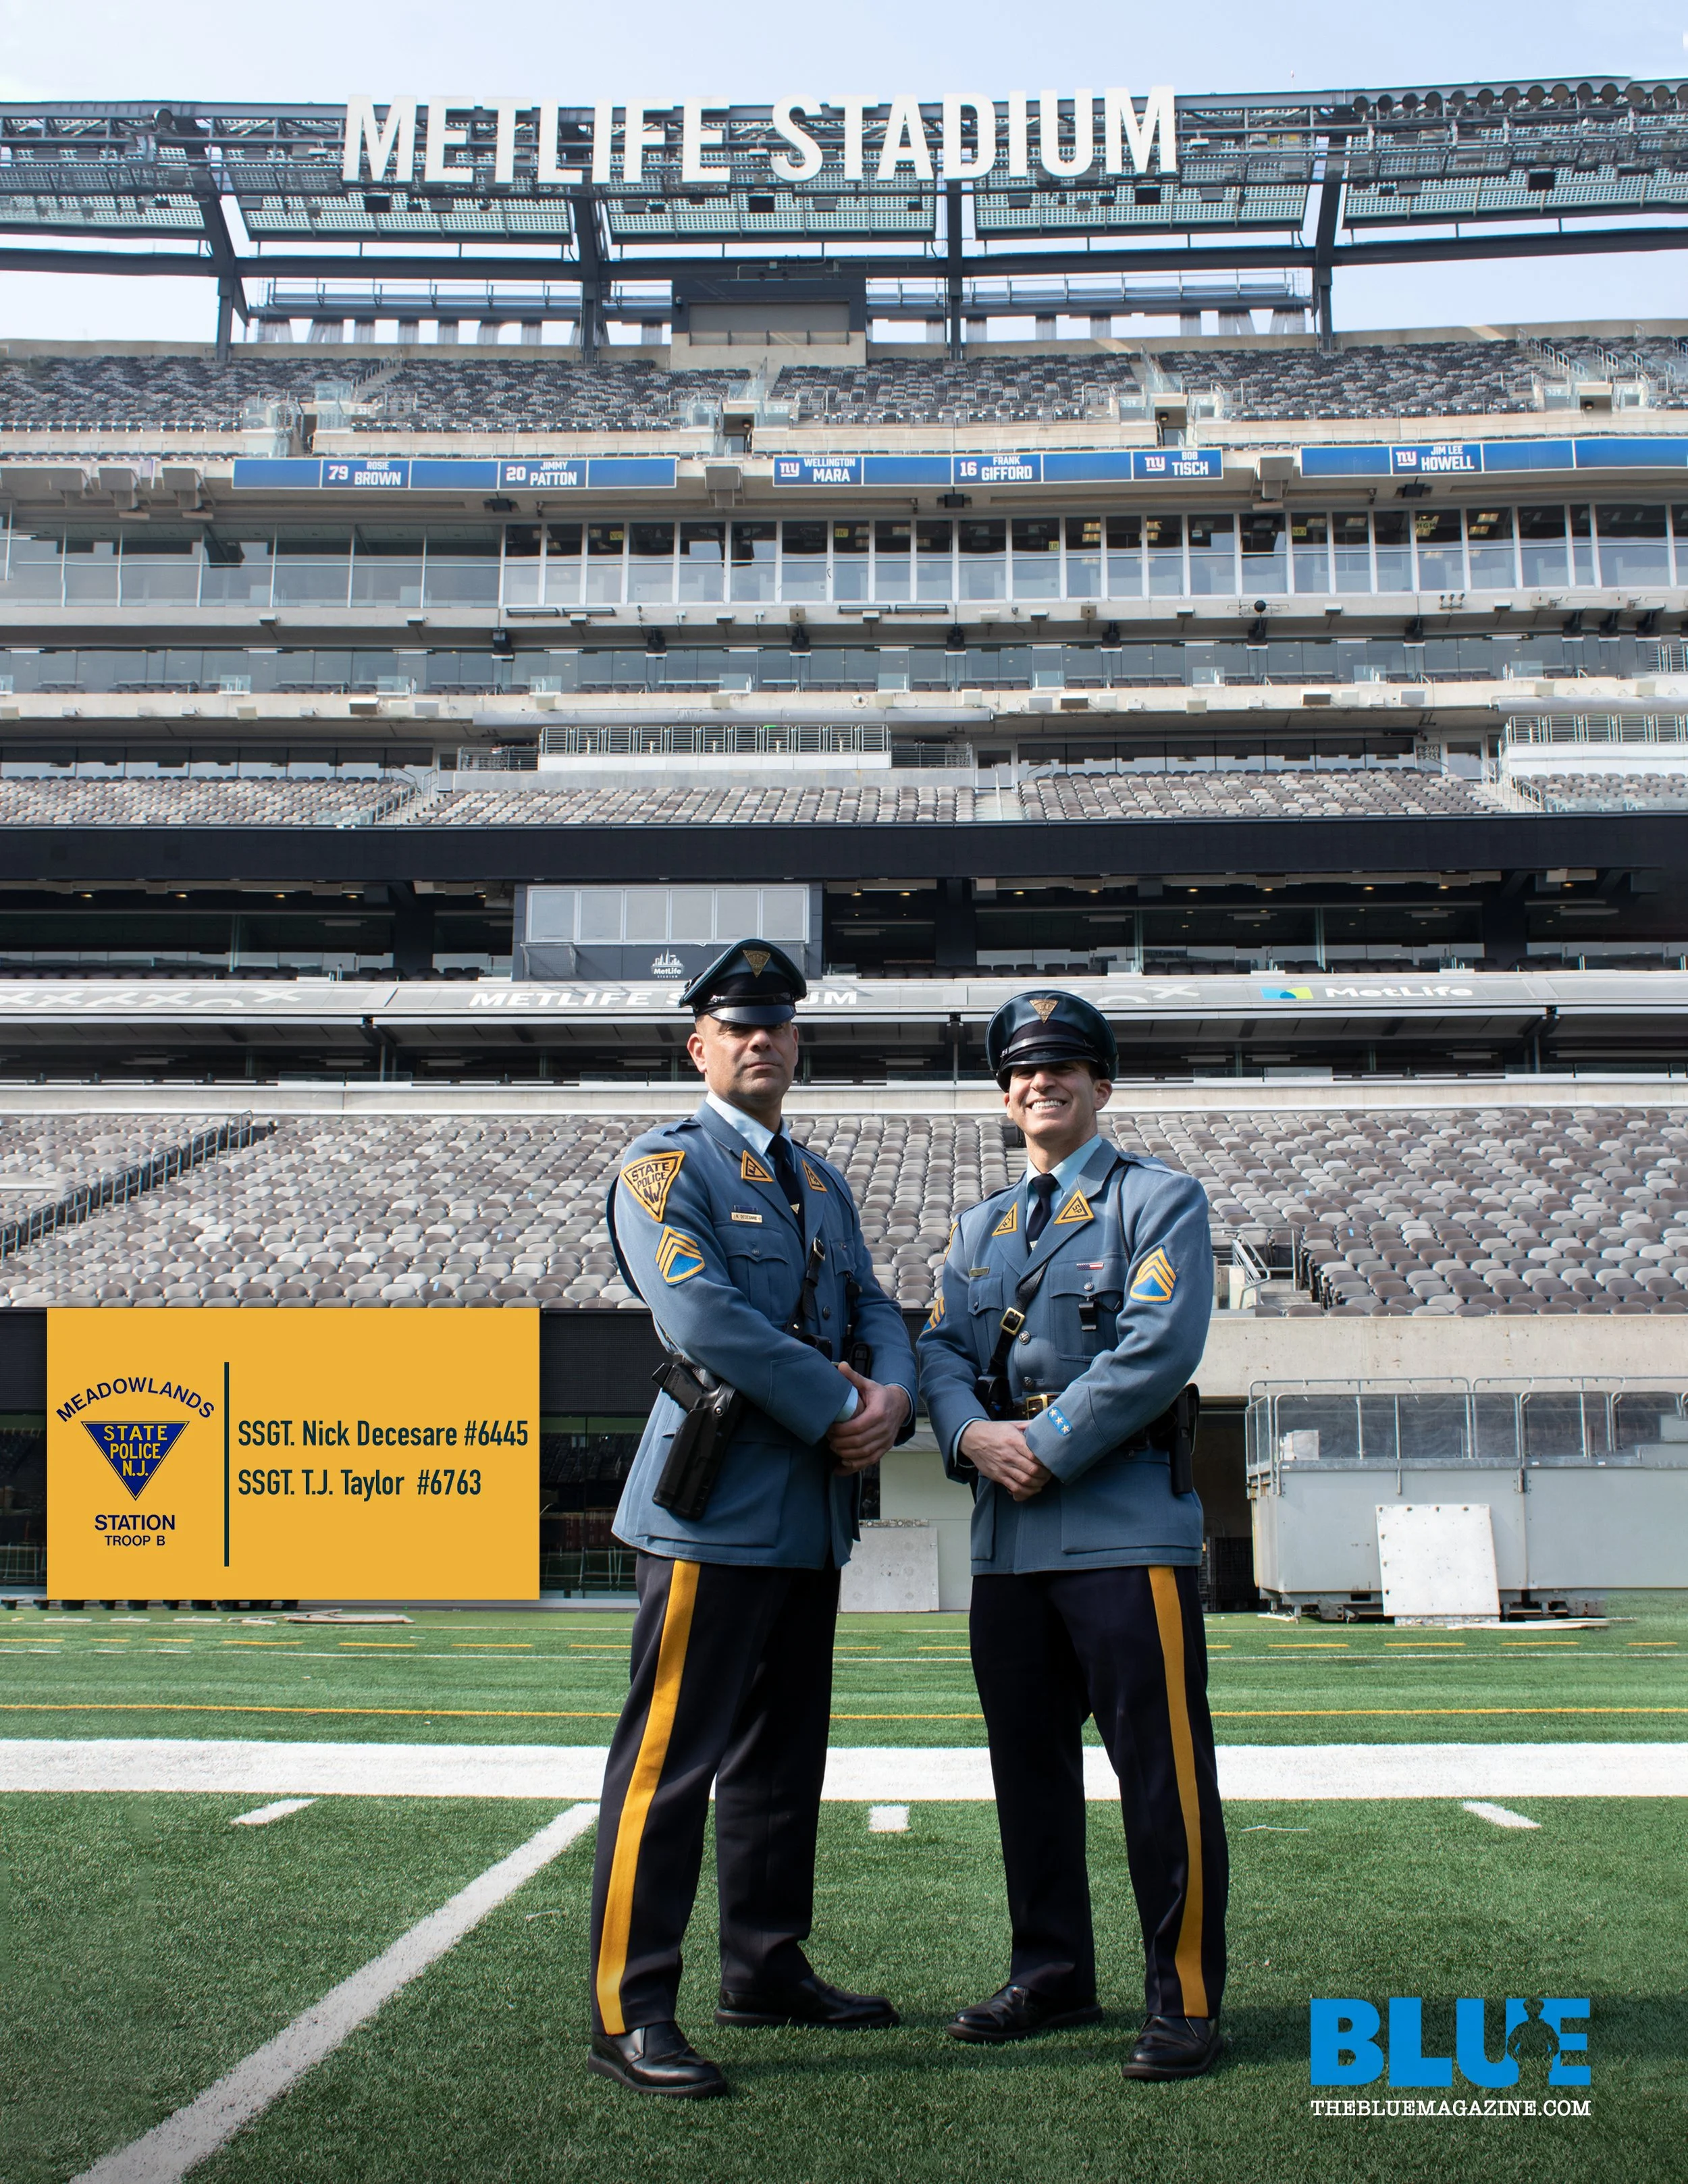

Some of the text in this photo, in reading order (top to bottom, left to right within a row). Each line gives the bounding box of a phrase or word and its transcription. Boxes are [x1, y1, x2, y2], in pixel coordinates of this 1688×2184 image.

[342, 85, 1177, 186] METLIFE STADIUM
[773, 405, 789, 413] 339
[1182, 451, 1198, 460] BOB
[1431, 446, 1463, 455] JIM LEE
[366, 461, 390, 471] ROSIE
[539, 461, 568, 471] JIMMY
[803, 458, 855, 467] WELLINGTON
[993, 456, 1020, 466] FRANK
[1421, 455, 1475, 471] HOWELL
[328, 465, 348, 480] 79
[506, 466, 526, 481] 20
[813, 468, 851, 482] MARA
[960, 461, 977, 477] 16
[981, 465, 1032, 481] GIFFORD
[1171, 461, 1209, 476] TISCH
[354, 471, 402, 485] BROWN
[529, 471, 577, 485] PATTON
[653, 967, 682, 975] MetLife
[1325, 986, 1474, 998] MetLife
[469, 991, 651, 1008] METLIFE
[631, 1161, 671, 1183] STATE
[636, 1171, 667, 1190] POLICE
